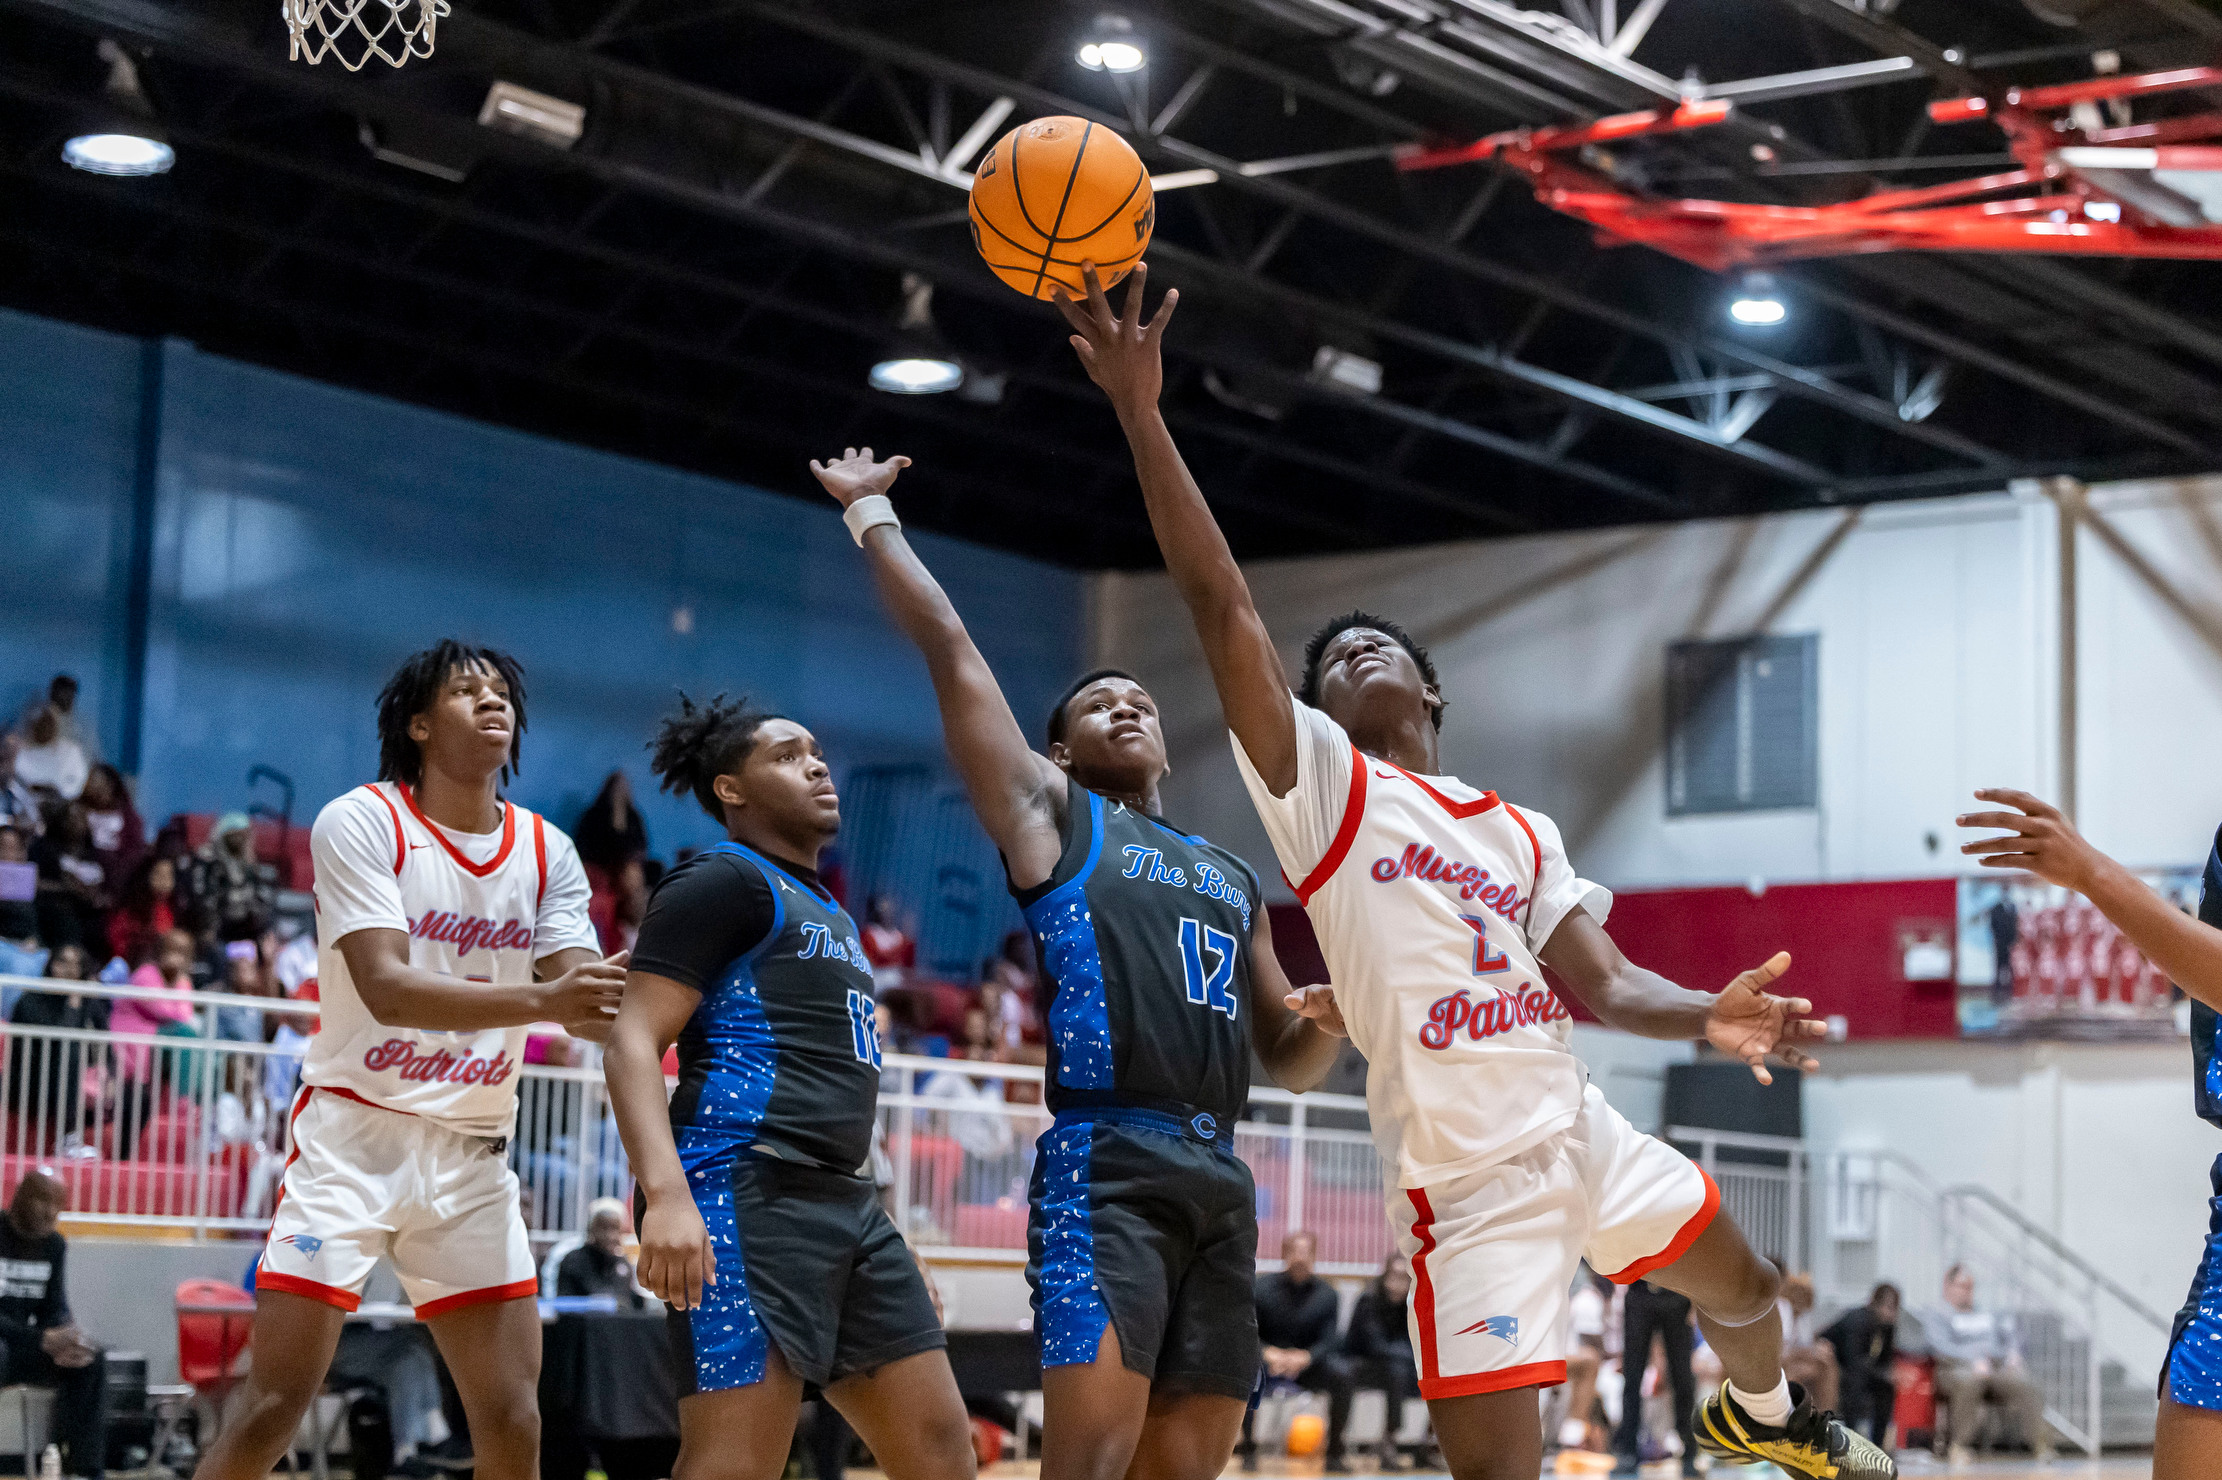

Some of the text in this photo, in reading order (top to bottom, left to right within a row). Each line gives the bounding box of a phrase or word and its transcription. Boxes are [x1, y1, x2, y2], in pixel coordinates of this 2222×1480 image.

[1122, 843, 1188, 888] The
[797, 920, 849, 962] The
[1458, 913, 1511, 977] 2
[1177, 916, 1238, 1021] 12
[364, 1037, 514, 1087] Patriots
[1190, 1112, 1217, 1140] C
